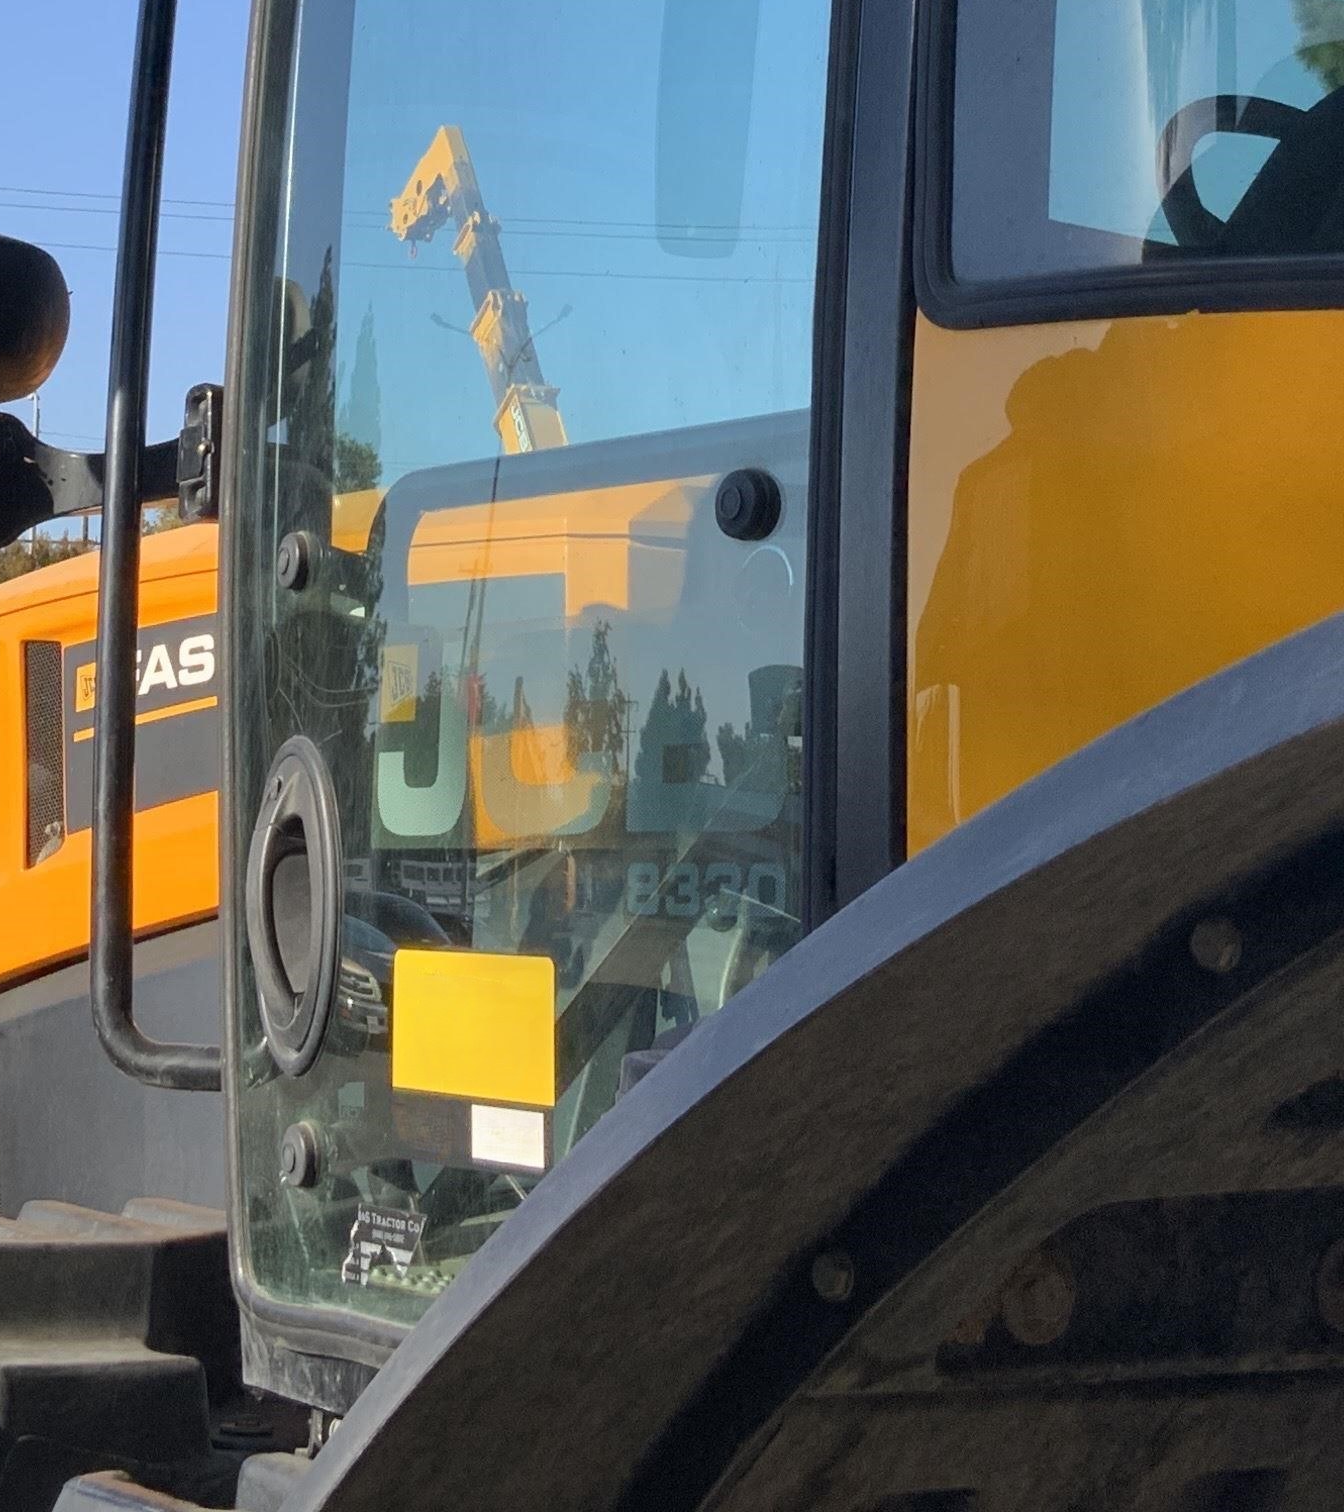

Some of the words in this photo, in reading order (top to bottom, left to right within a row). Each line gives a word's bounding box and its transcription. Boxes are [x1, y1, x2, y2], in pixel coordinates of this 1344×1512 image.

[136, 634, 215, 696] AS
[627, 862, 786, 916] 8330
[371, 1212, 406, 1231] TRACTOR
